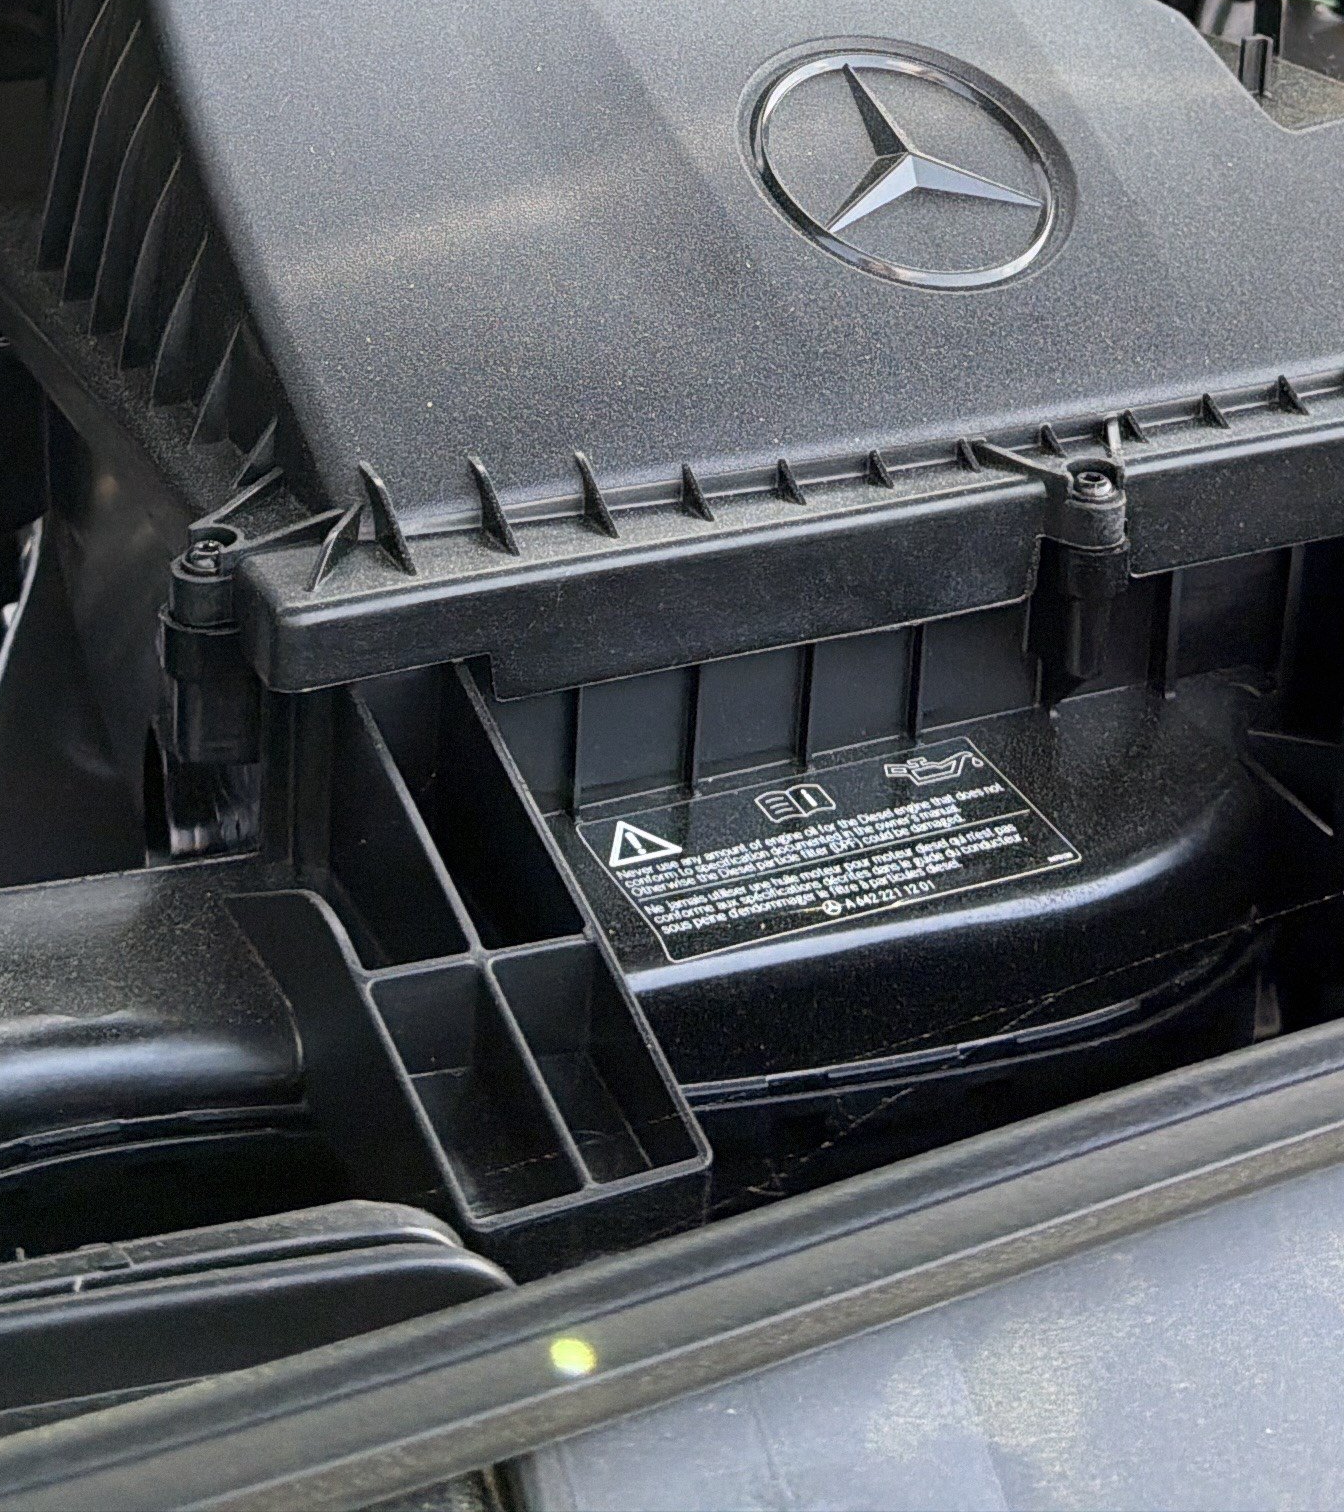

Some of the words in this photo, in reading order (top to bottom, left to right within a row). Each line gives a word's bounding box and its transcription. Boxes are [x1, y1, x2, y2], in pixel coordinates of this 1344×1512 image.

[614, 864, 654, 880] Never
[655, 860, 679, 872] use
[679, 854, 702, 866] any
[702, 842, 749, 861] amount
[748, 838, 763, 850] of
[763, 830, 804, 848] engine
[803, 825, 819, 837] oil
[816, 822, 836, 834] for
[836, 817, 859, 829] the
[855, 807, 894, 825] Diesel
[892, 800, 931, 816] engine
[929, 793, 956, 806] that
[954, 787, 985, 801] does
[982, 781, 1005, 794] not
[844, 897, 856, 909] A
[855, 891, 880, 907] 642
[877, 886, 903, 901] 221
